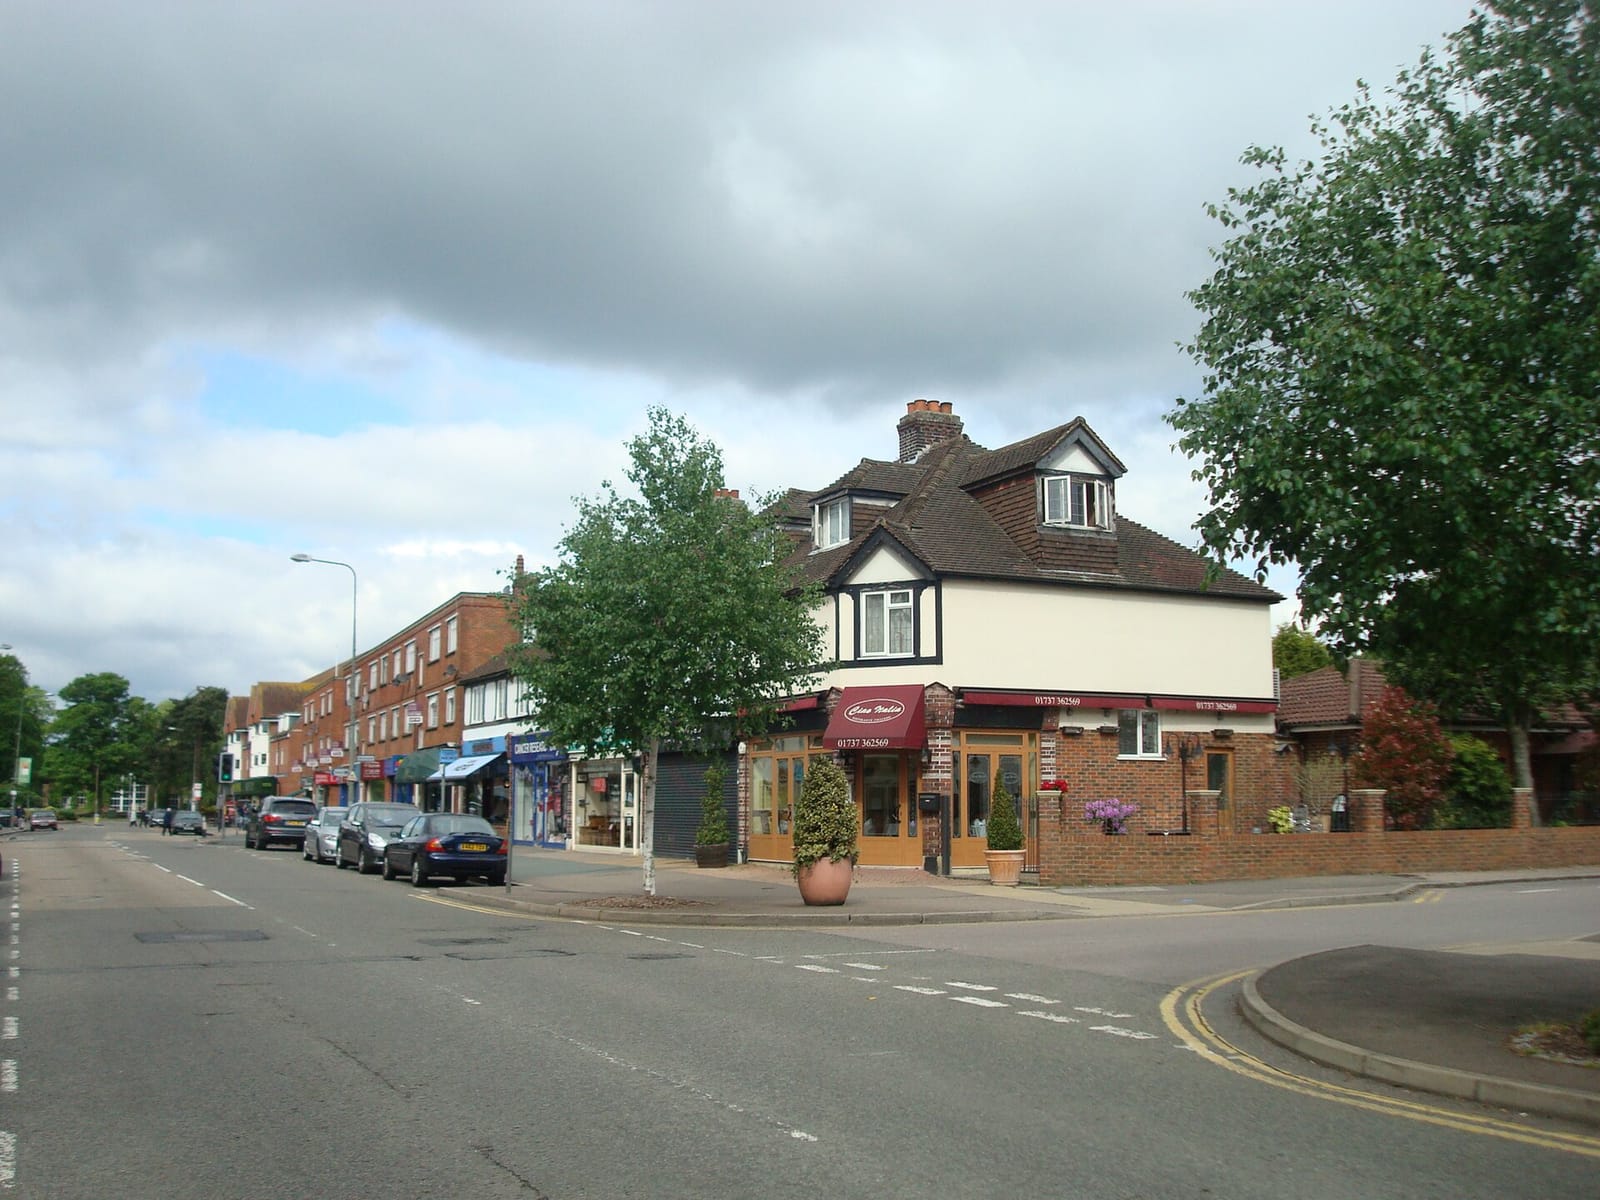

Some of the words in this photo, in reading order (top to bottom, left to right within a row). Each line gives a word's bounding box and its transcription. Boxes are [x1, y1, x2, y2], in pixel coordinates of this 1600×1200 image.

[1035, 696, 1055, 705] 01737
[1056, 697, 1080, 706] 362569
[848, 706, 872, 715] Ciao
[1196, 702, 1214, 710] 01737
[838, 739, 860, 748] 01737
[862, 738, 888, 747] 362569
